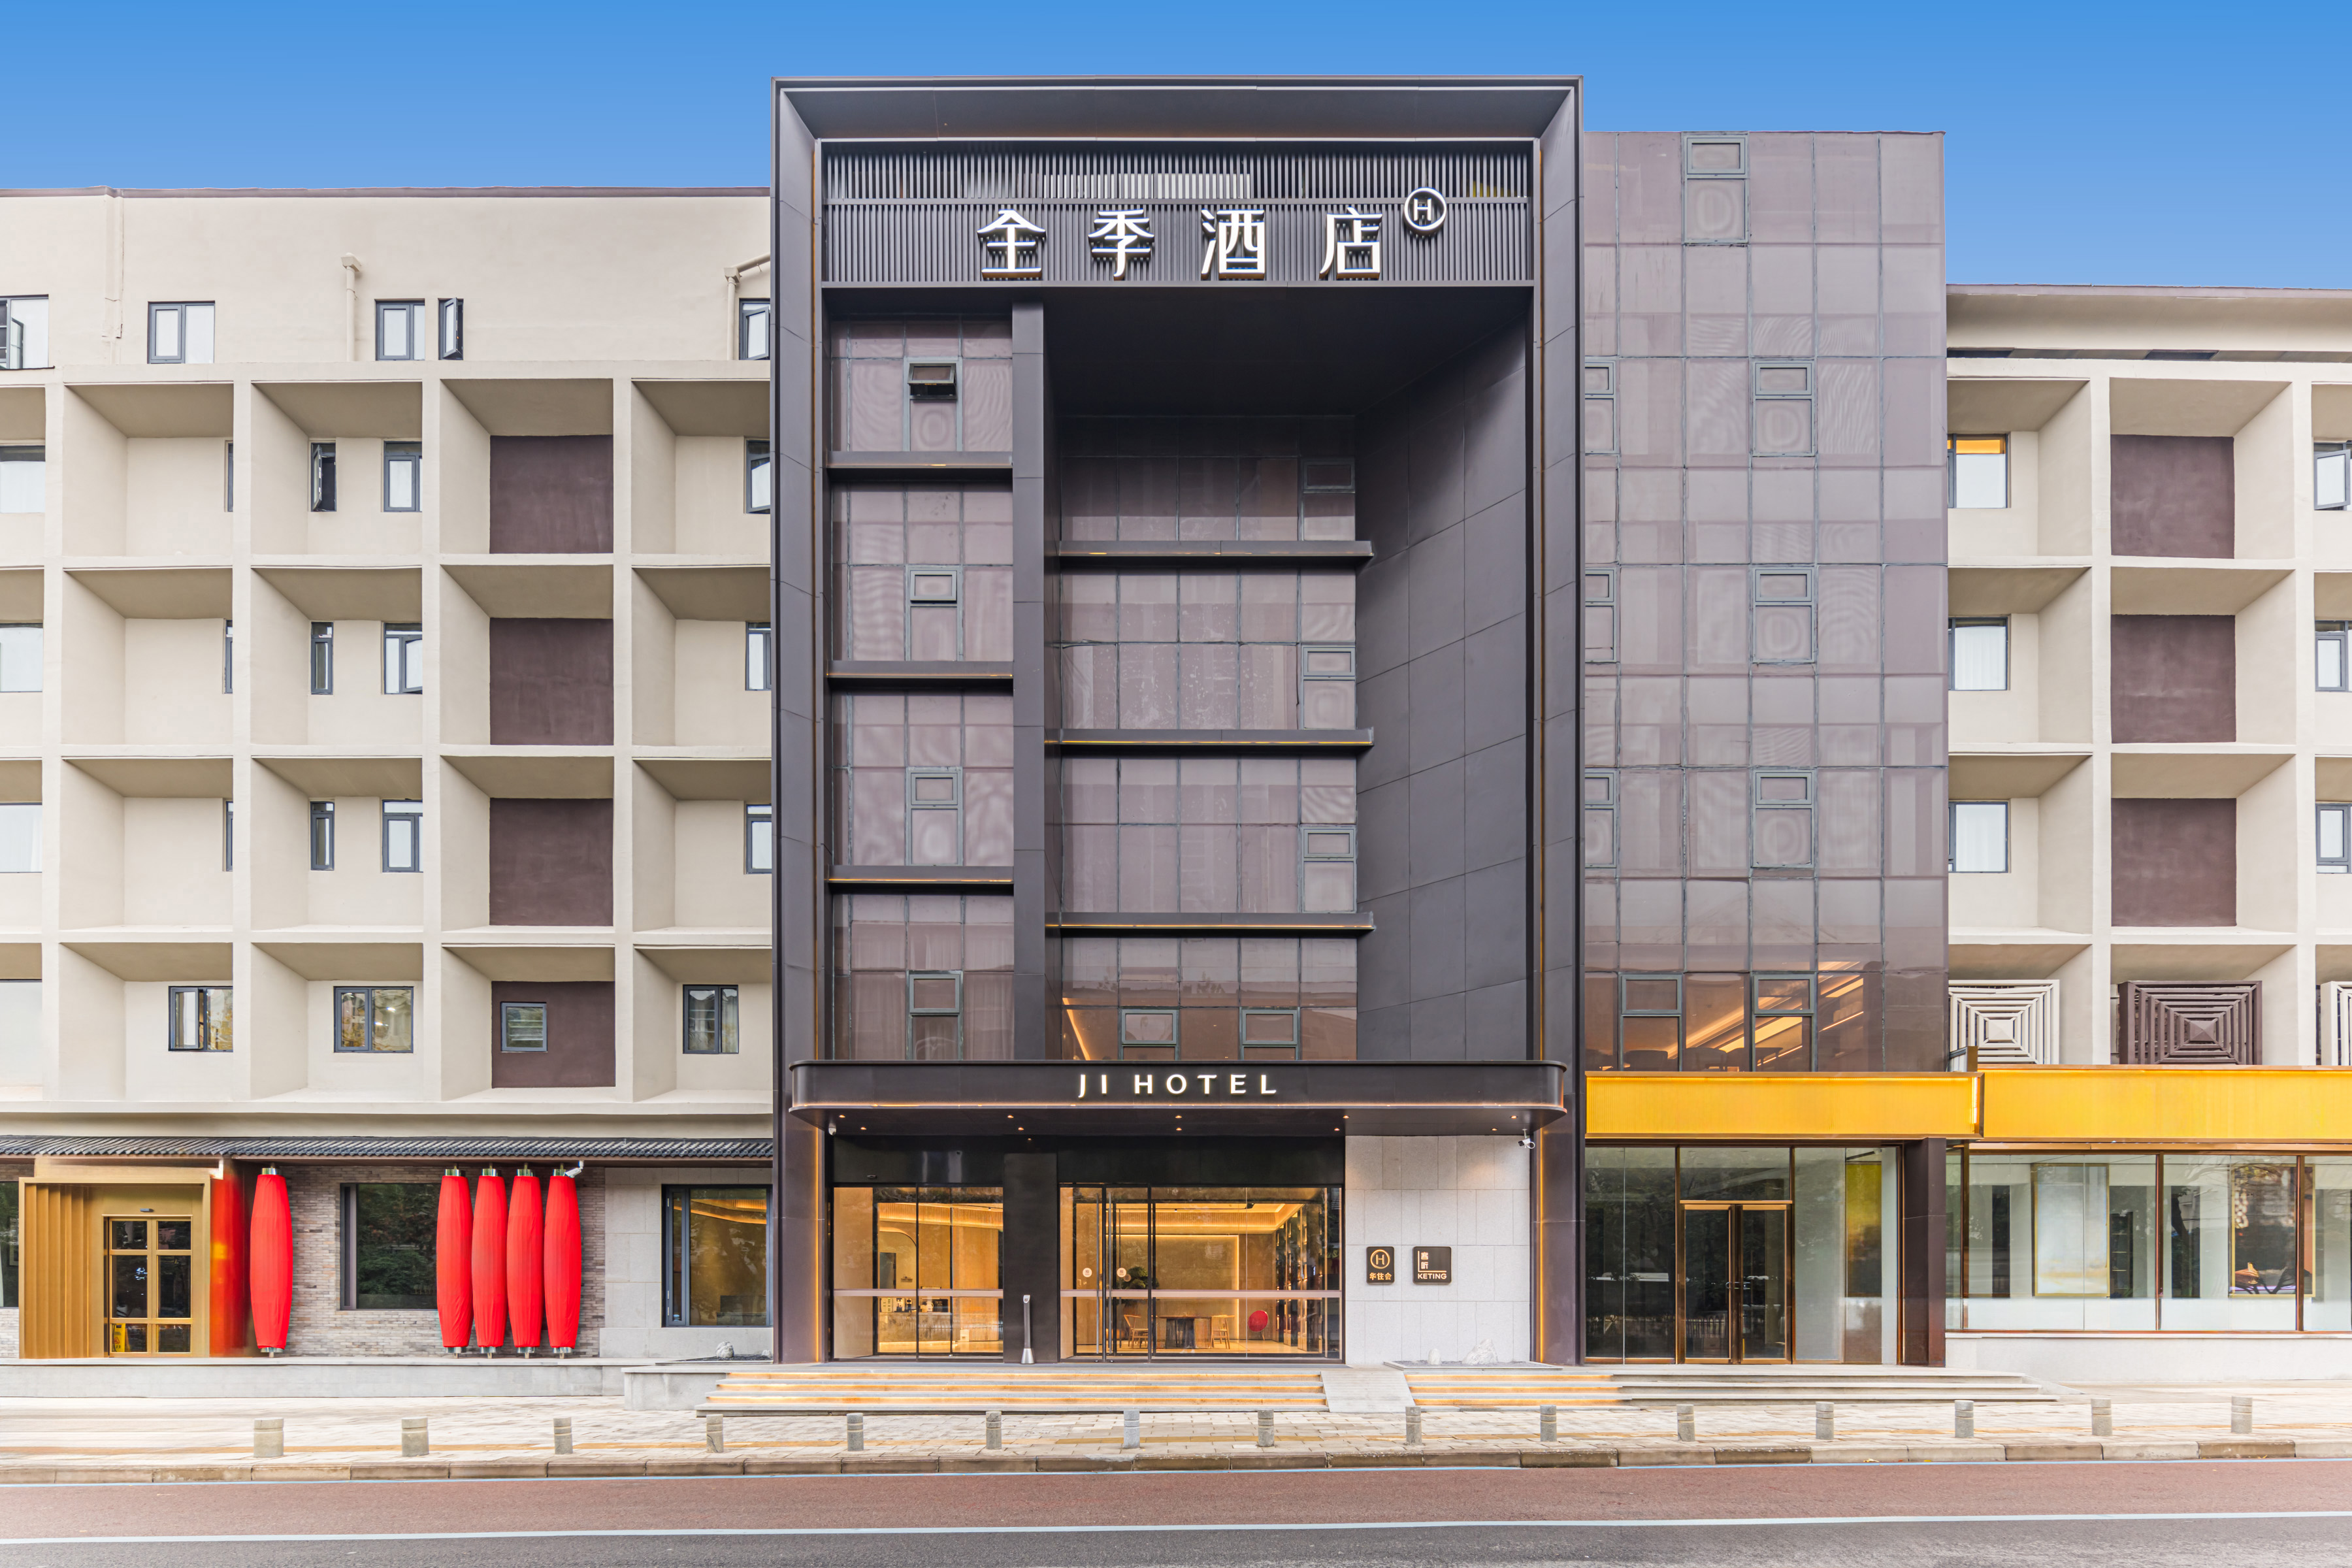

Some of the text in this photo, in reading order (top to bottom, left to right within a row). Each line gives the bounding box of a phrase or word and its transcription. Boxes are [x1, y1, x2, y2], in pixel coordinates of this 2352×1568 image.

[977, 206, 1383, 280] 全季酒店
[1078, 1074, 1277, 1098] JI HOTEL
[1369, 1272, 1392, 1281] 华住会
